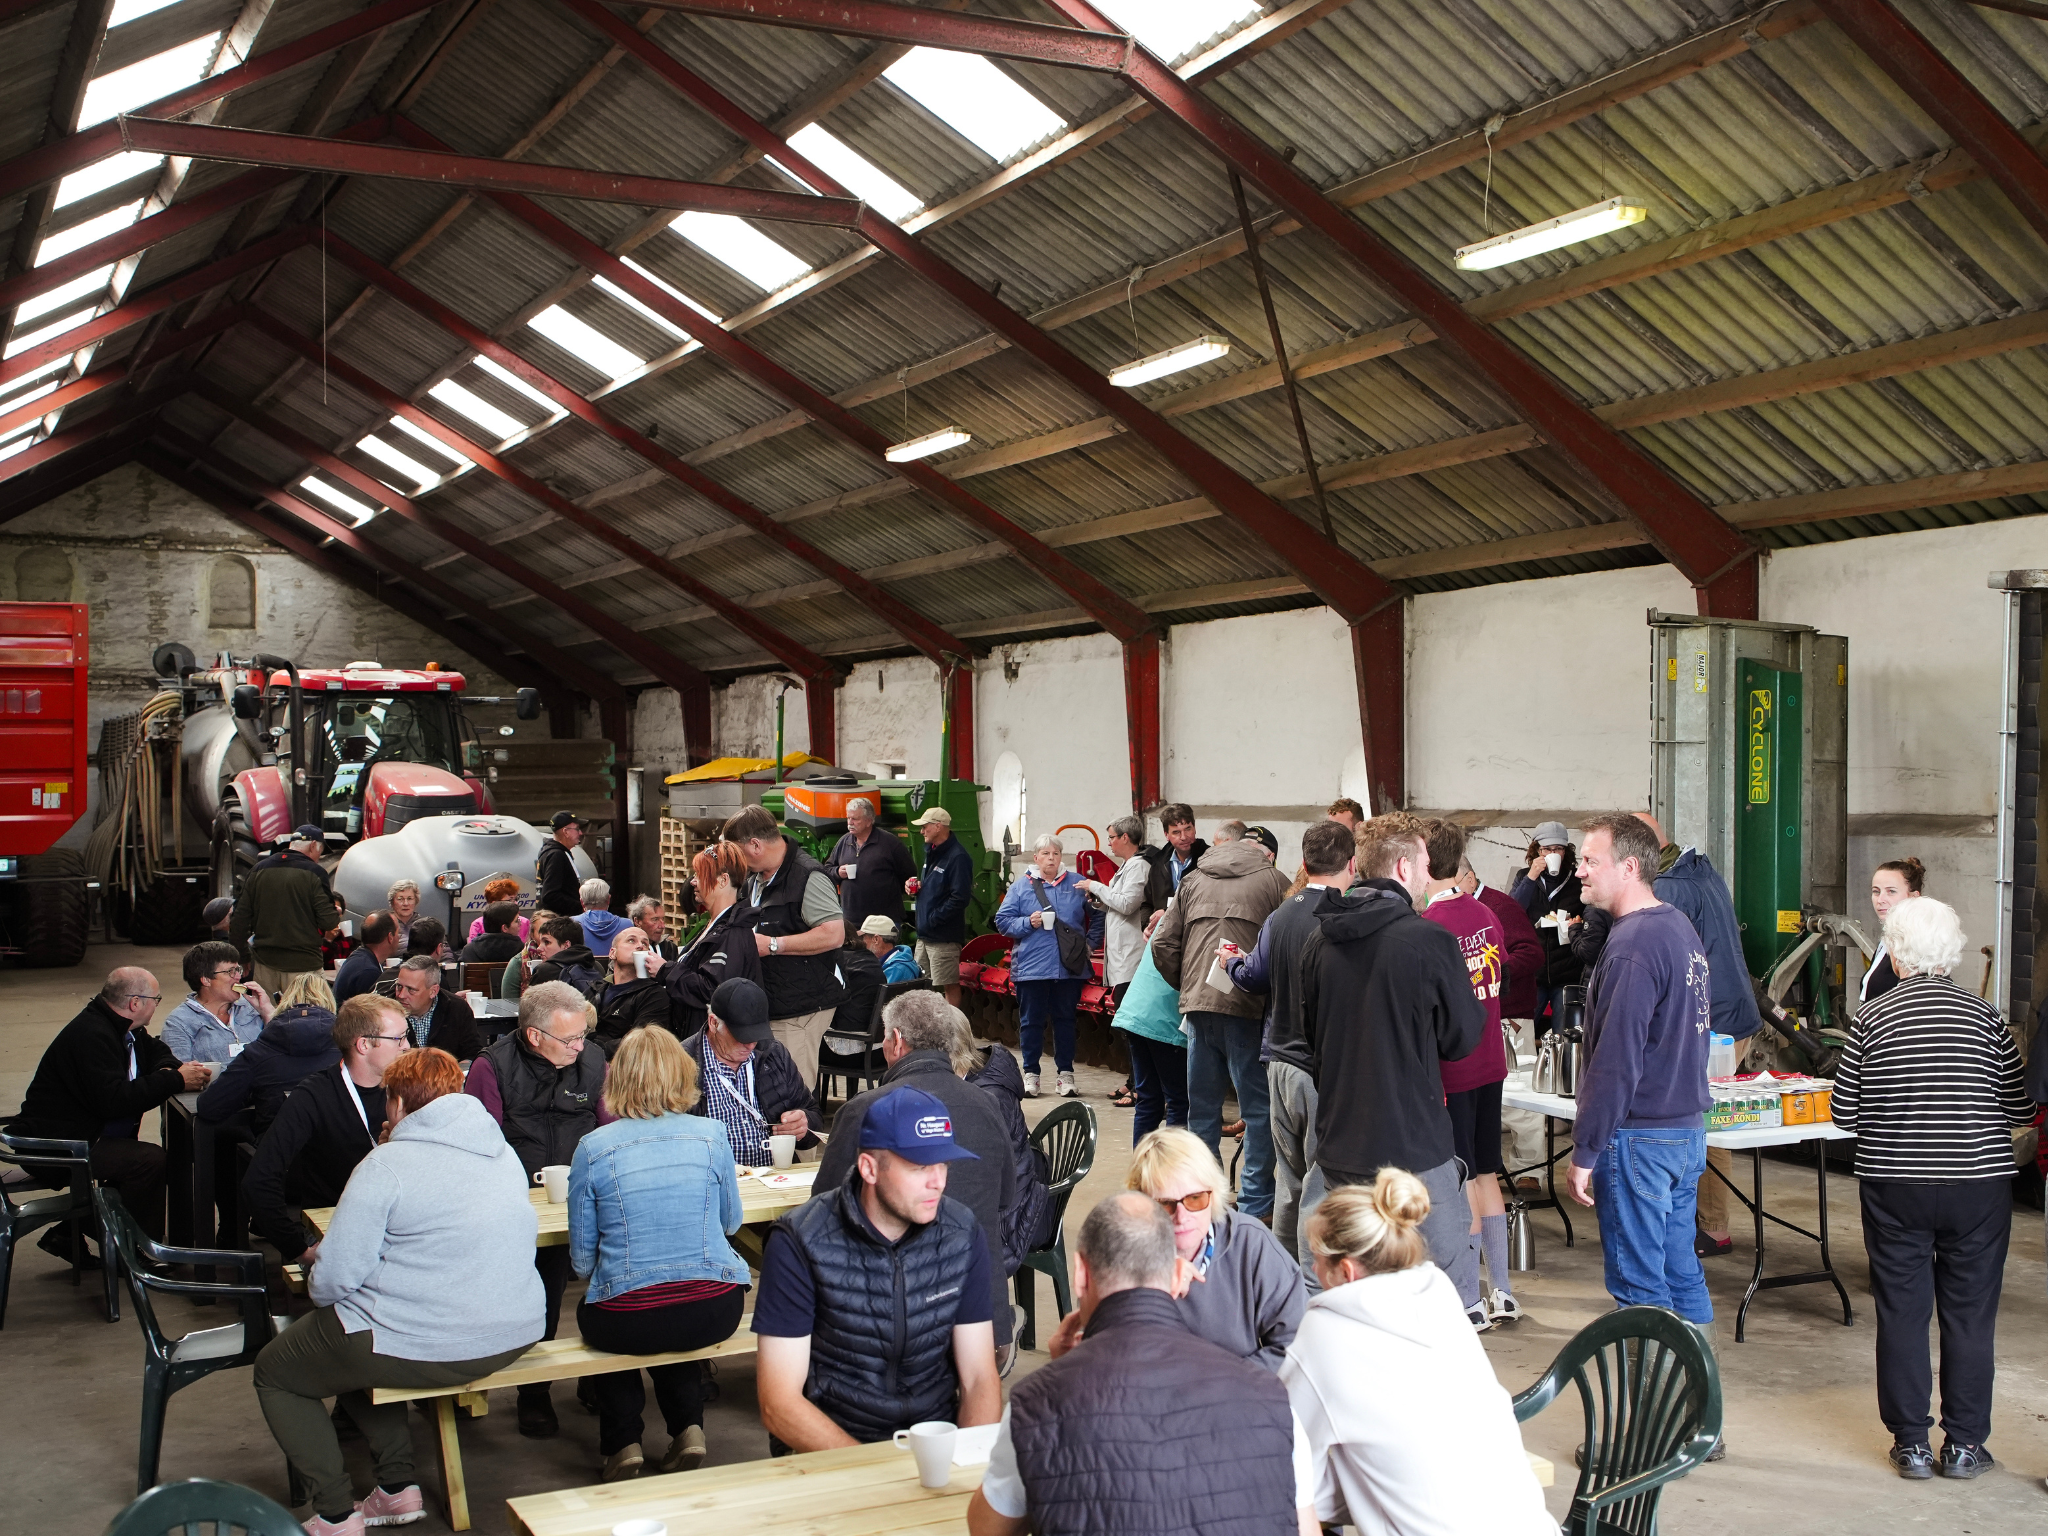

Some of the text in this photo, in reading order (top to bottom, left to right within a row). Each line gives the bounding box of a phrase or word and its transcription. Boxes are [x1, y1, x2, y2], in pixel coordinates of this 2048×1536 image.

[1752, 706, 1764, 800] CYCLONE
[1470, 971, 1484, 986] VS
[1710, 1113, 1760, 1125] FAXE KONDI
